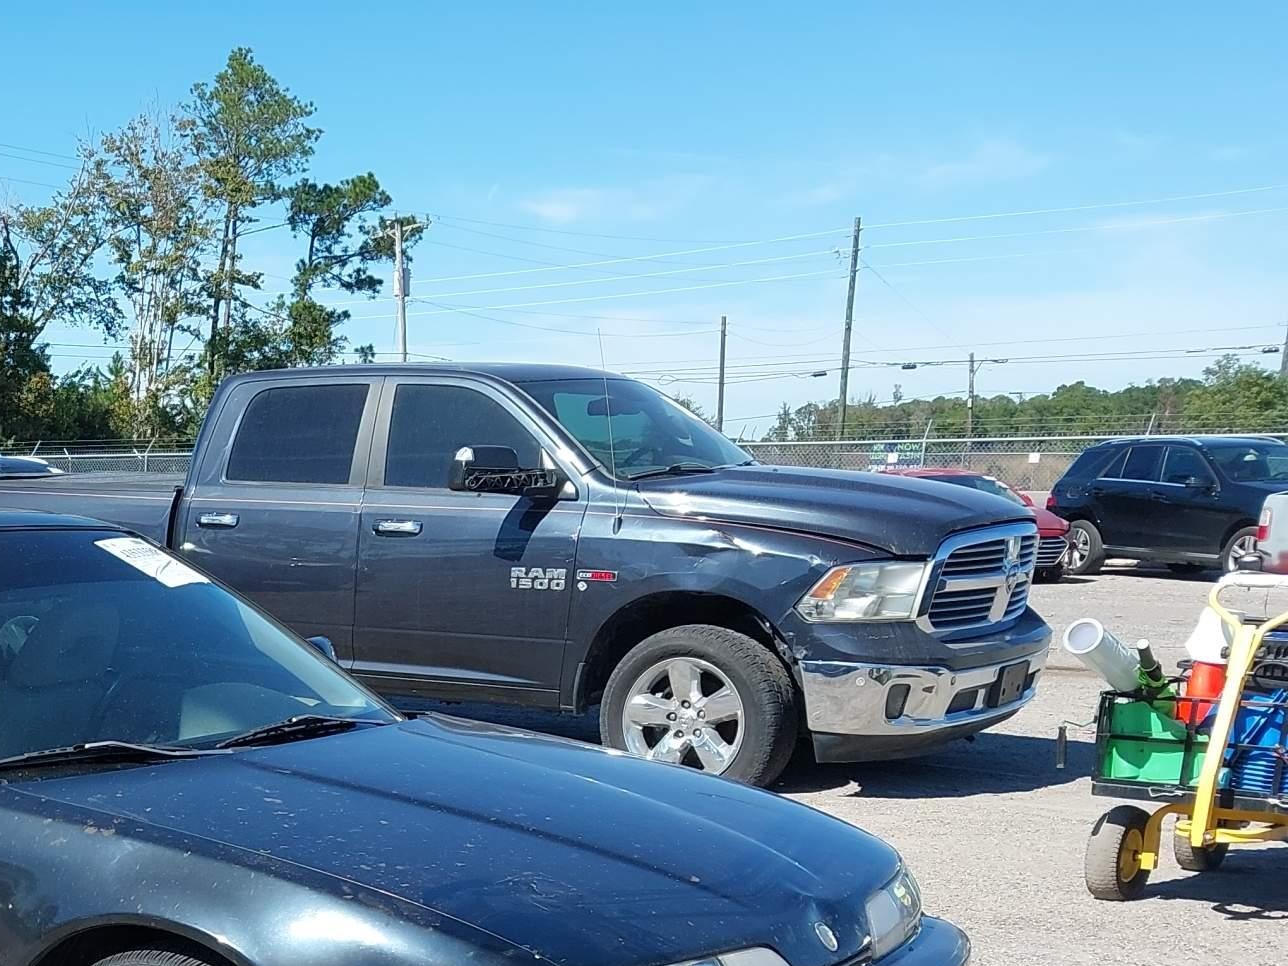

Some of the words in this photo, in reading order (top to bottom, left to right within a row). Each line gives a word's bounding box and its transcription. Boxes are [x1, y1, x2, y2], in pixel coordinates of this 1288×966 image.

[897, 442, 920, 451] NOW
[511, 567, 567, 579] RAM
[510, 579, 566, 591] 1500
